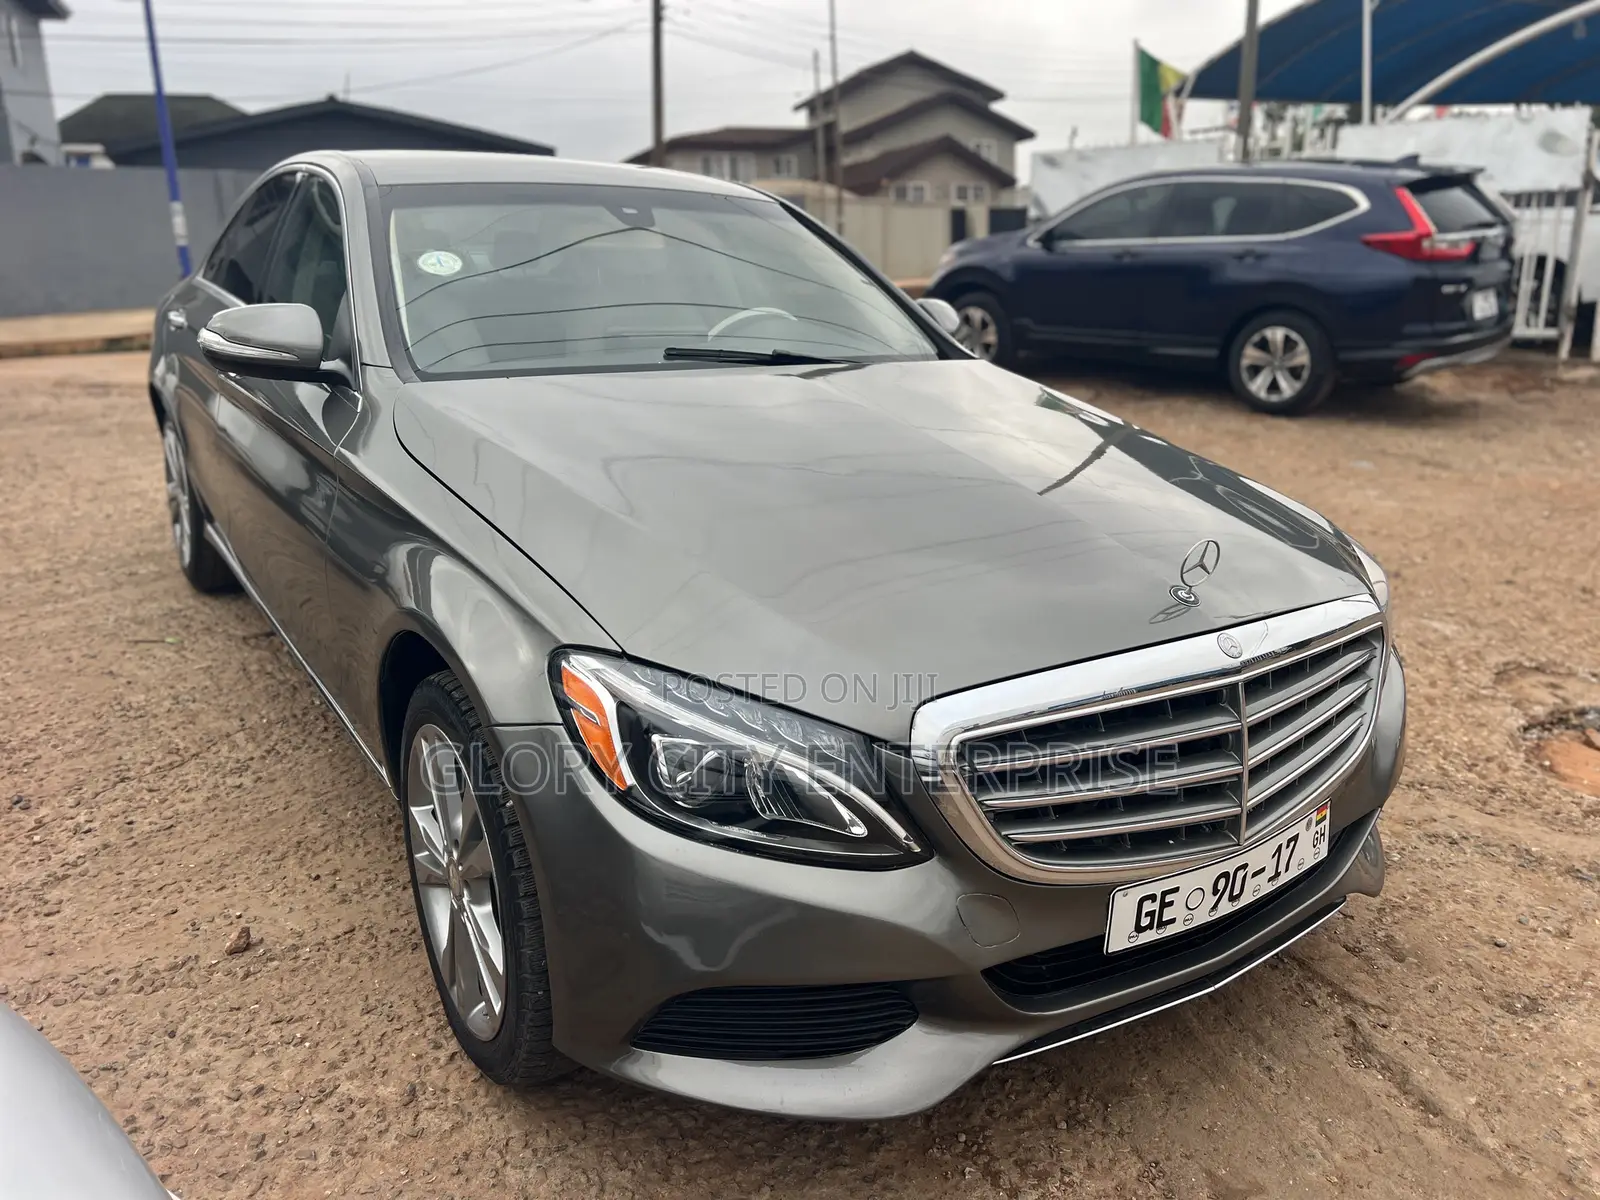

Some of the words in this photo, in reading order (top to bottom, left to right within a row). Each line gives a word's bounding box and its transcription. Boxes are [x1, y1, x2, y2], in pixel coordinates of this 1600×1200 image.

[1312, 824, 1326, 849] GH
[1134, 885, 1180, 934] GE
[1211, 832, 1300, 910] 90-17
